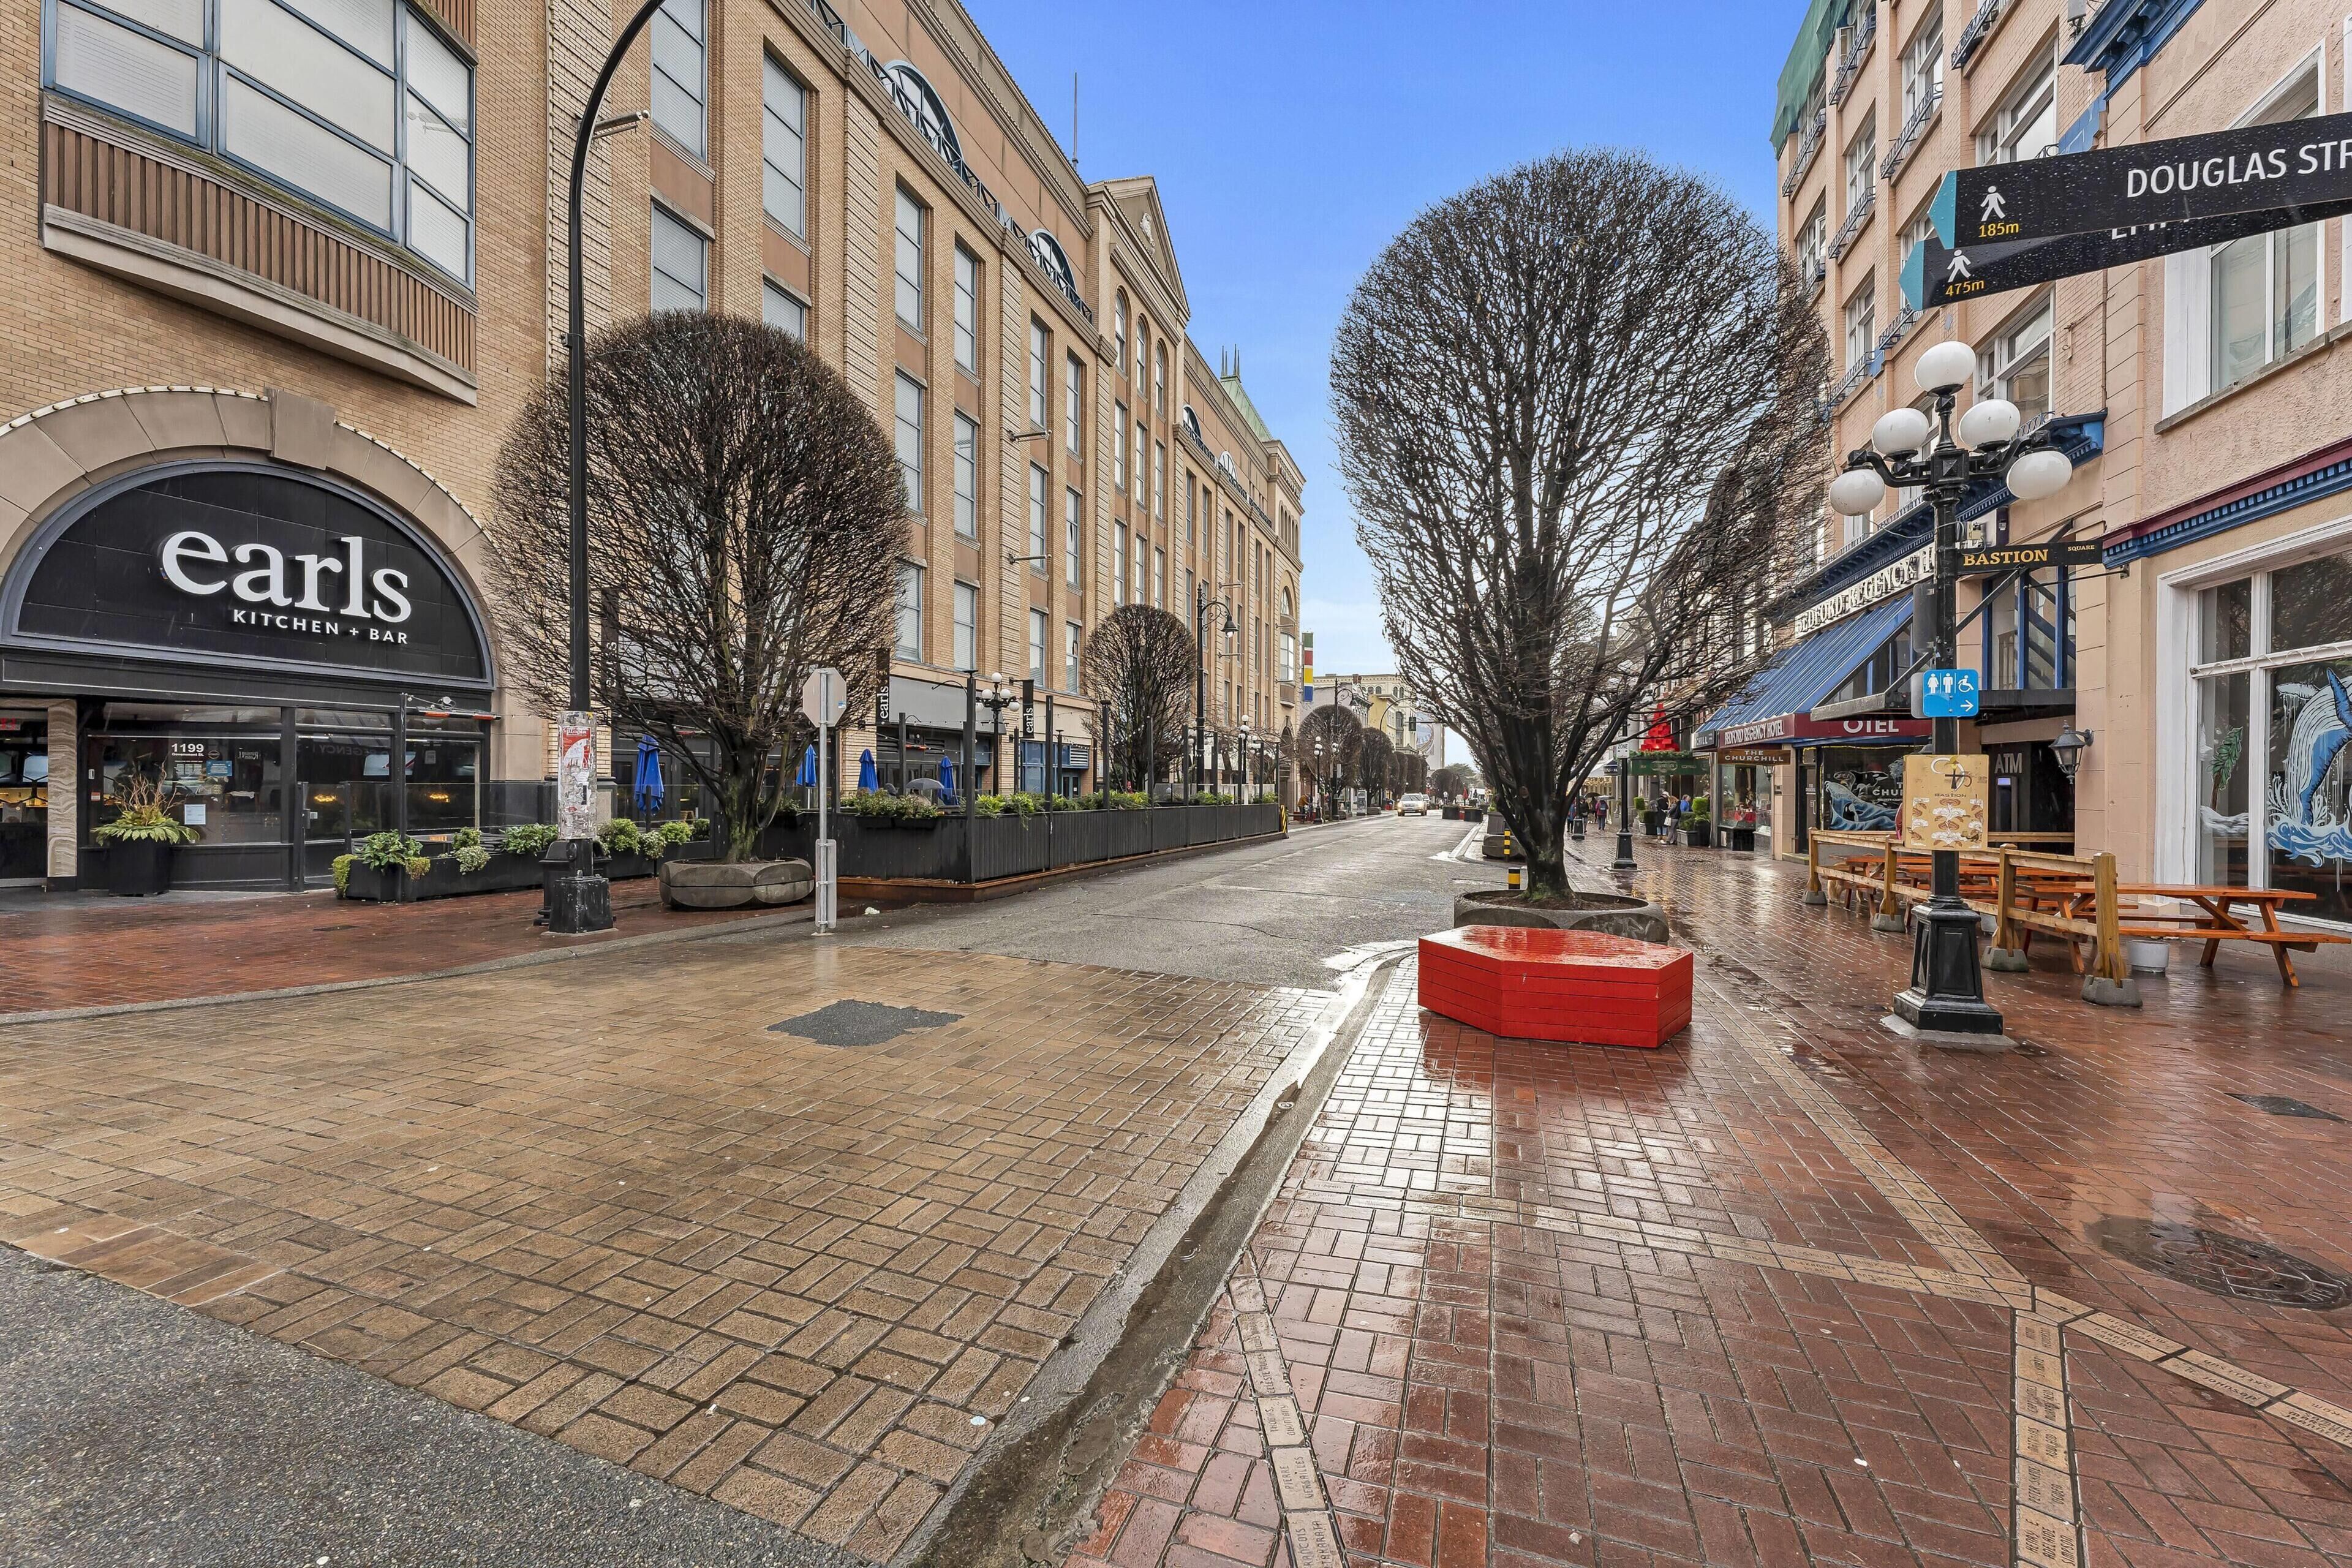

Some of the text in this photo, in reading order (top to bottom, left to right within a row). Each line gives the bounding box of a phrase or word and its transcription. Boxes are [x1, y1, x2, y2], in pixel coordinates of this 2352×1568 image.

[2127, 147, 2287, 198] DOUGLAS
[1978, 222, 2019, 238] 185m
[1945, 279, 1985, 297] 475m
[1963, 549, 2049, 567] BASTION
[162, 531, 412, 623] earls
[233, 608, 339, 635] KITCHEN
[369, 628, 408, 644] BAR
[876, 685, 889, 719] earls
[1023, 707, 1033, 733] earls
[1767, 720, 1784, 738] HOTEL
[172, 743, 205, 753] 1199
[1994, 753, 2022, 774] ATM
[2024, 1529, 2040, 1555] HENRY
[2041, 1526, 2057, 1561] ADELAIDE
[2059, 1534, 2076, 1567] SIMPSON
